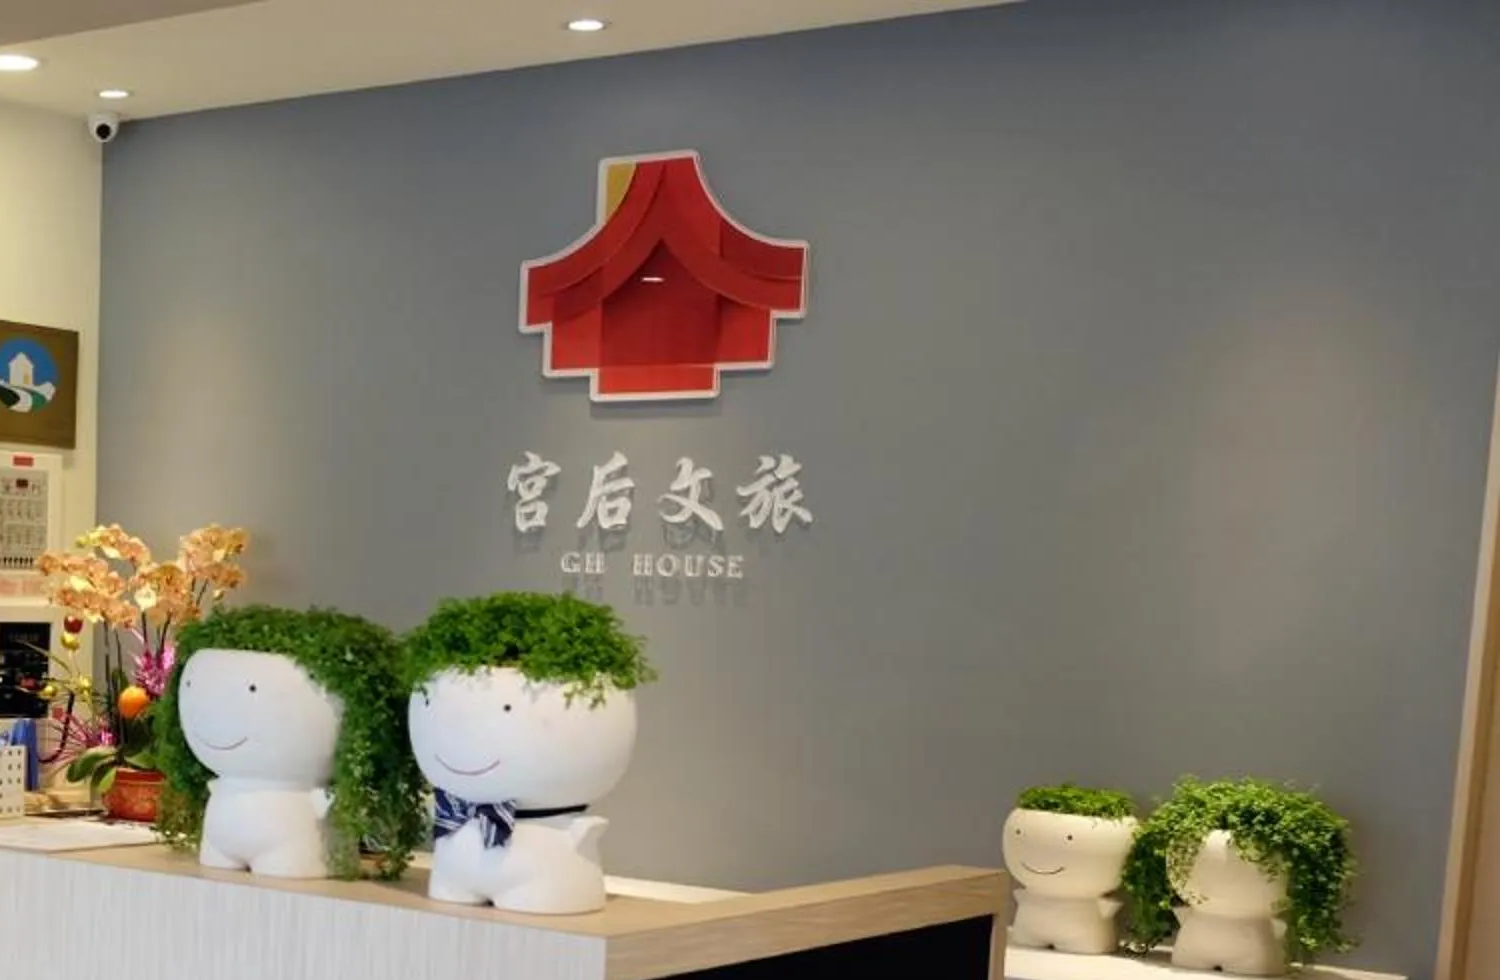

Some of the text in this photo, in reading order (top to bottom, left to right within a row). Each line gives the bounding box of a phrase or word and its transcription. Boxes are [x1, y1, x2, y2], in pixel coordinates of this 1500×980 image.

[506, 450, 814, 534] 宮后文旅
[560, 551, 745, 579] GH HOUSE
